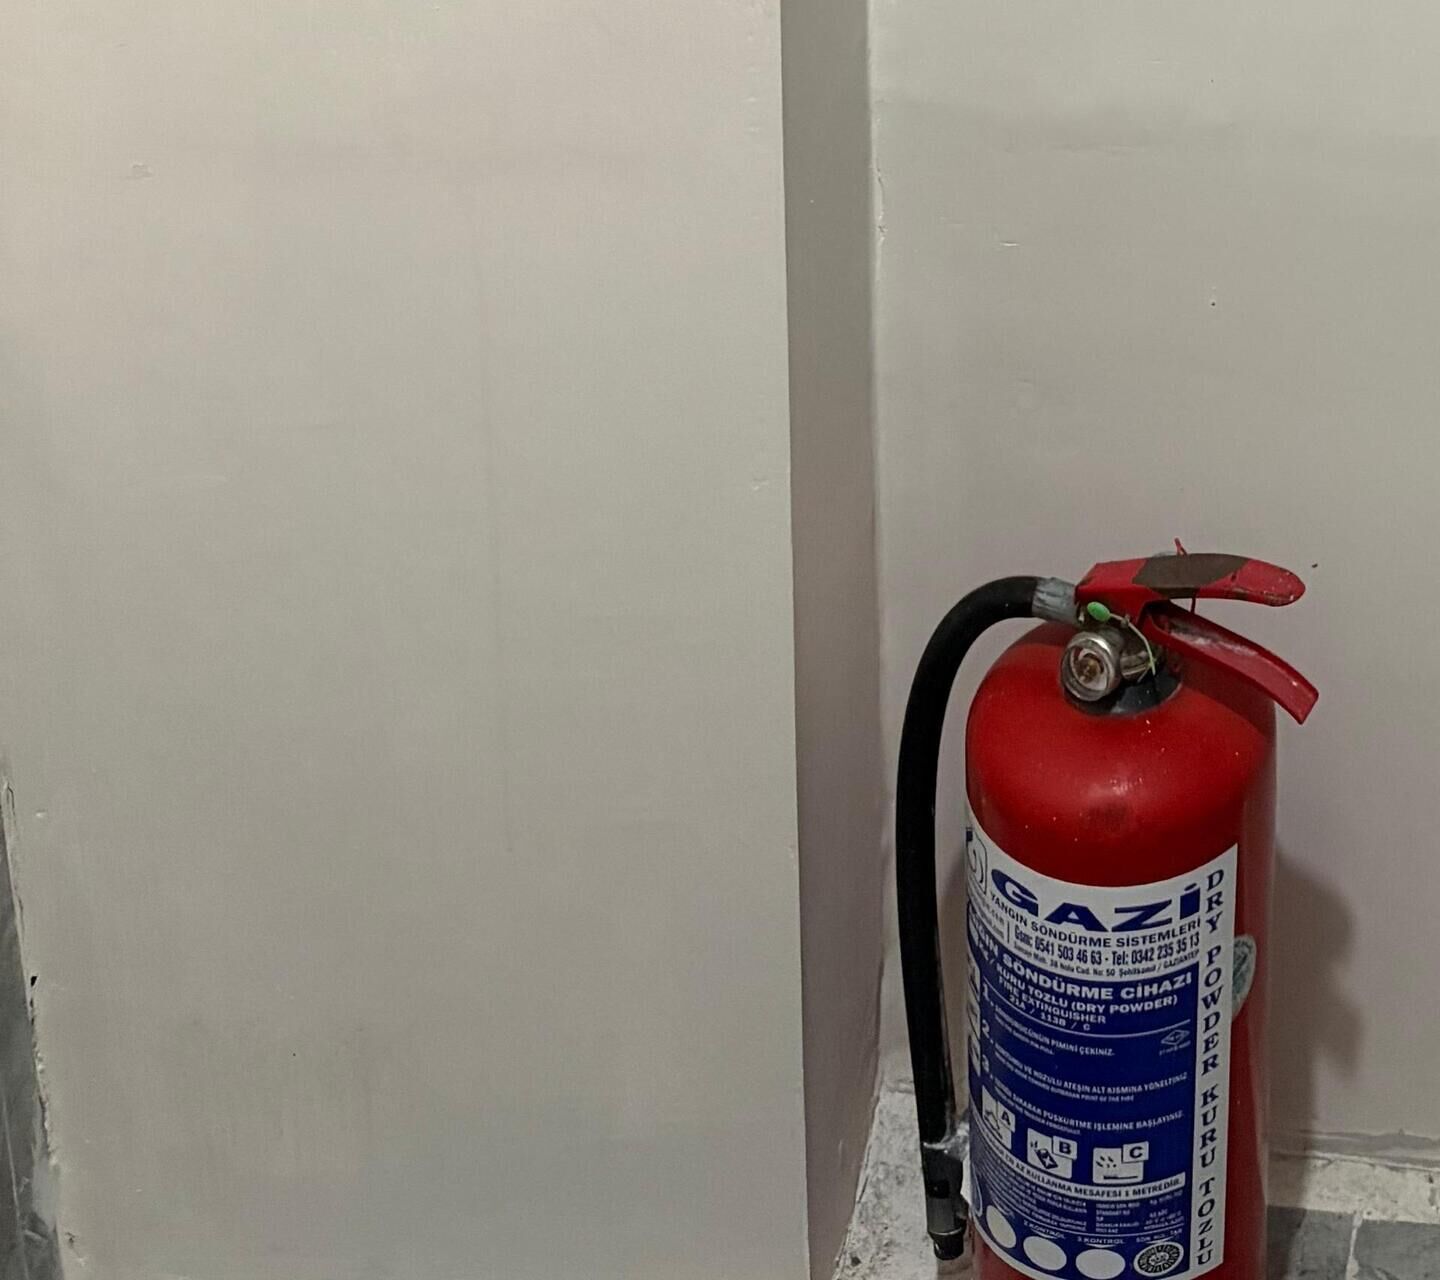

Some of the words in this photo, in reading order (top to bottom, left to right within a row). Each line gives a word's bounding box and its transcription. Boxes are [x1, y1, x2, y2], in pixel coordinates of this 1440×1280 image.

[991, 868, 1200, 933] GAZİ
[991, 893, 1027, 927] YANGIN
[1206, 869, 1224, 934] DRY
[1035, 936, 1054, 956] 0541
[1058, 944, 1074, 961] 503
[1077, 949, 1087, 964] 46
[1091, 951, 1101, 965] 63
[1112, 951, 1128, 965] Tel:
[1132, 947, 1154, 964] 0342
[1157, 942, 1173, 960] 235
[1176, 937, 1187, 954] 35
[1190, 931, 1199, 948] 13
[1003, 953, 1113, 1000] SÖNDÜRME
[1120, 971, 1192, 1000] CİHAZI
[1022, 993, 1106, 1024] EXTINGUISHER
[1029, 982, 1068, 1009] TOZLU
[1071, 1000, 1107, 1015] (DRY
[1110, 995, 1178, 1014] POWDER)
[1201, 945, 1223, 1076] POWDER
[1002, 1110, 1010, 1126] A
[1200, 1083, 1219, 1169] KURU
[1059, 1141, 1071, 1155] B
[1130, 1146, 1143, 1159] C
[1027, 1168, 1072, 1193] KULLANMA
[1197, 1176, 1215, 1266] TOZLU
